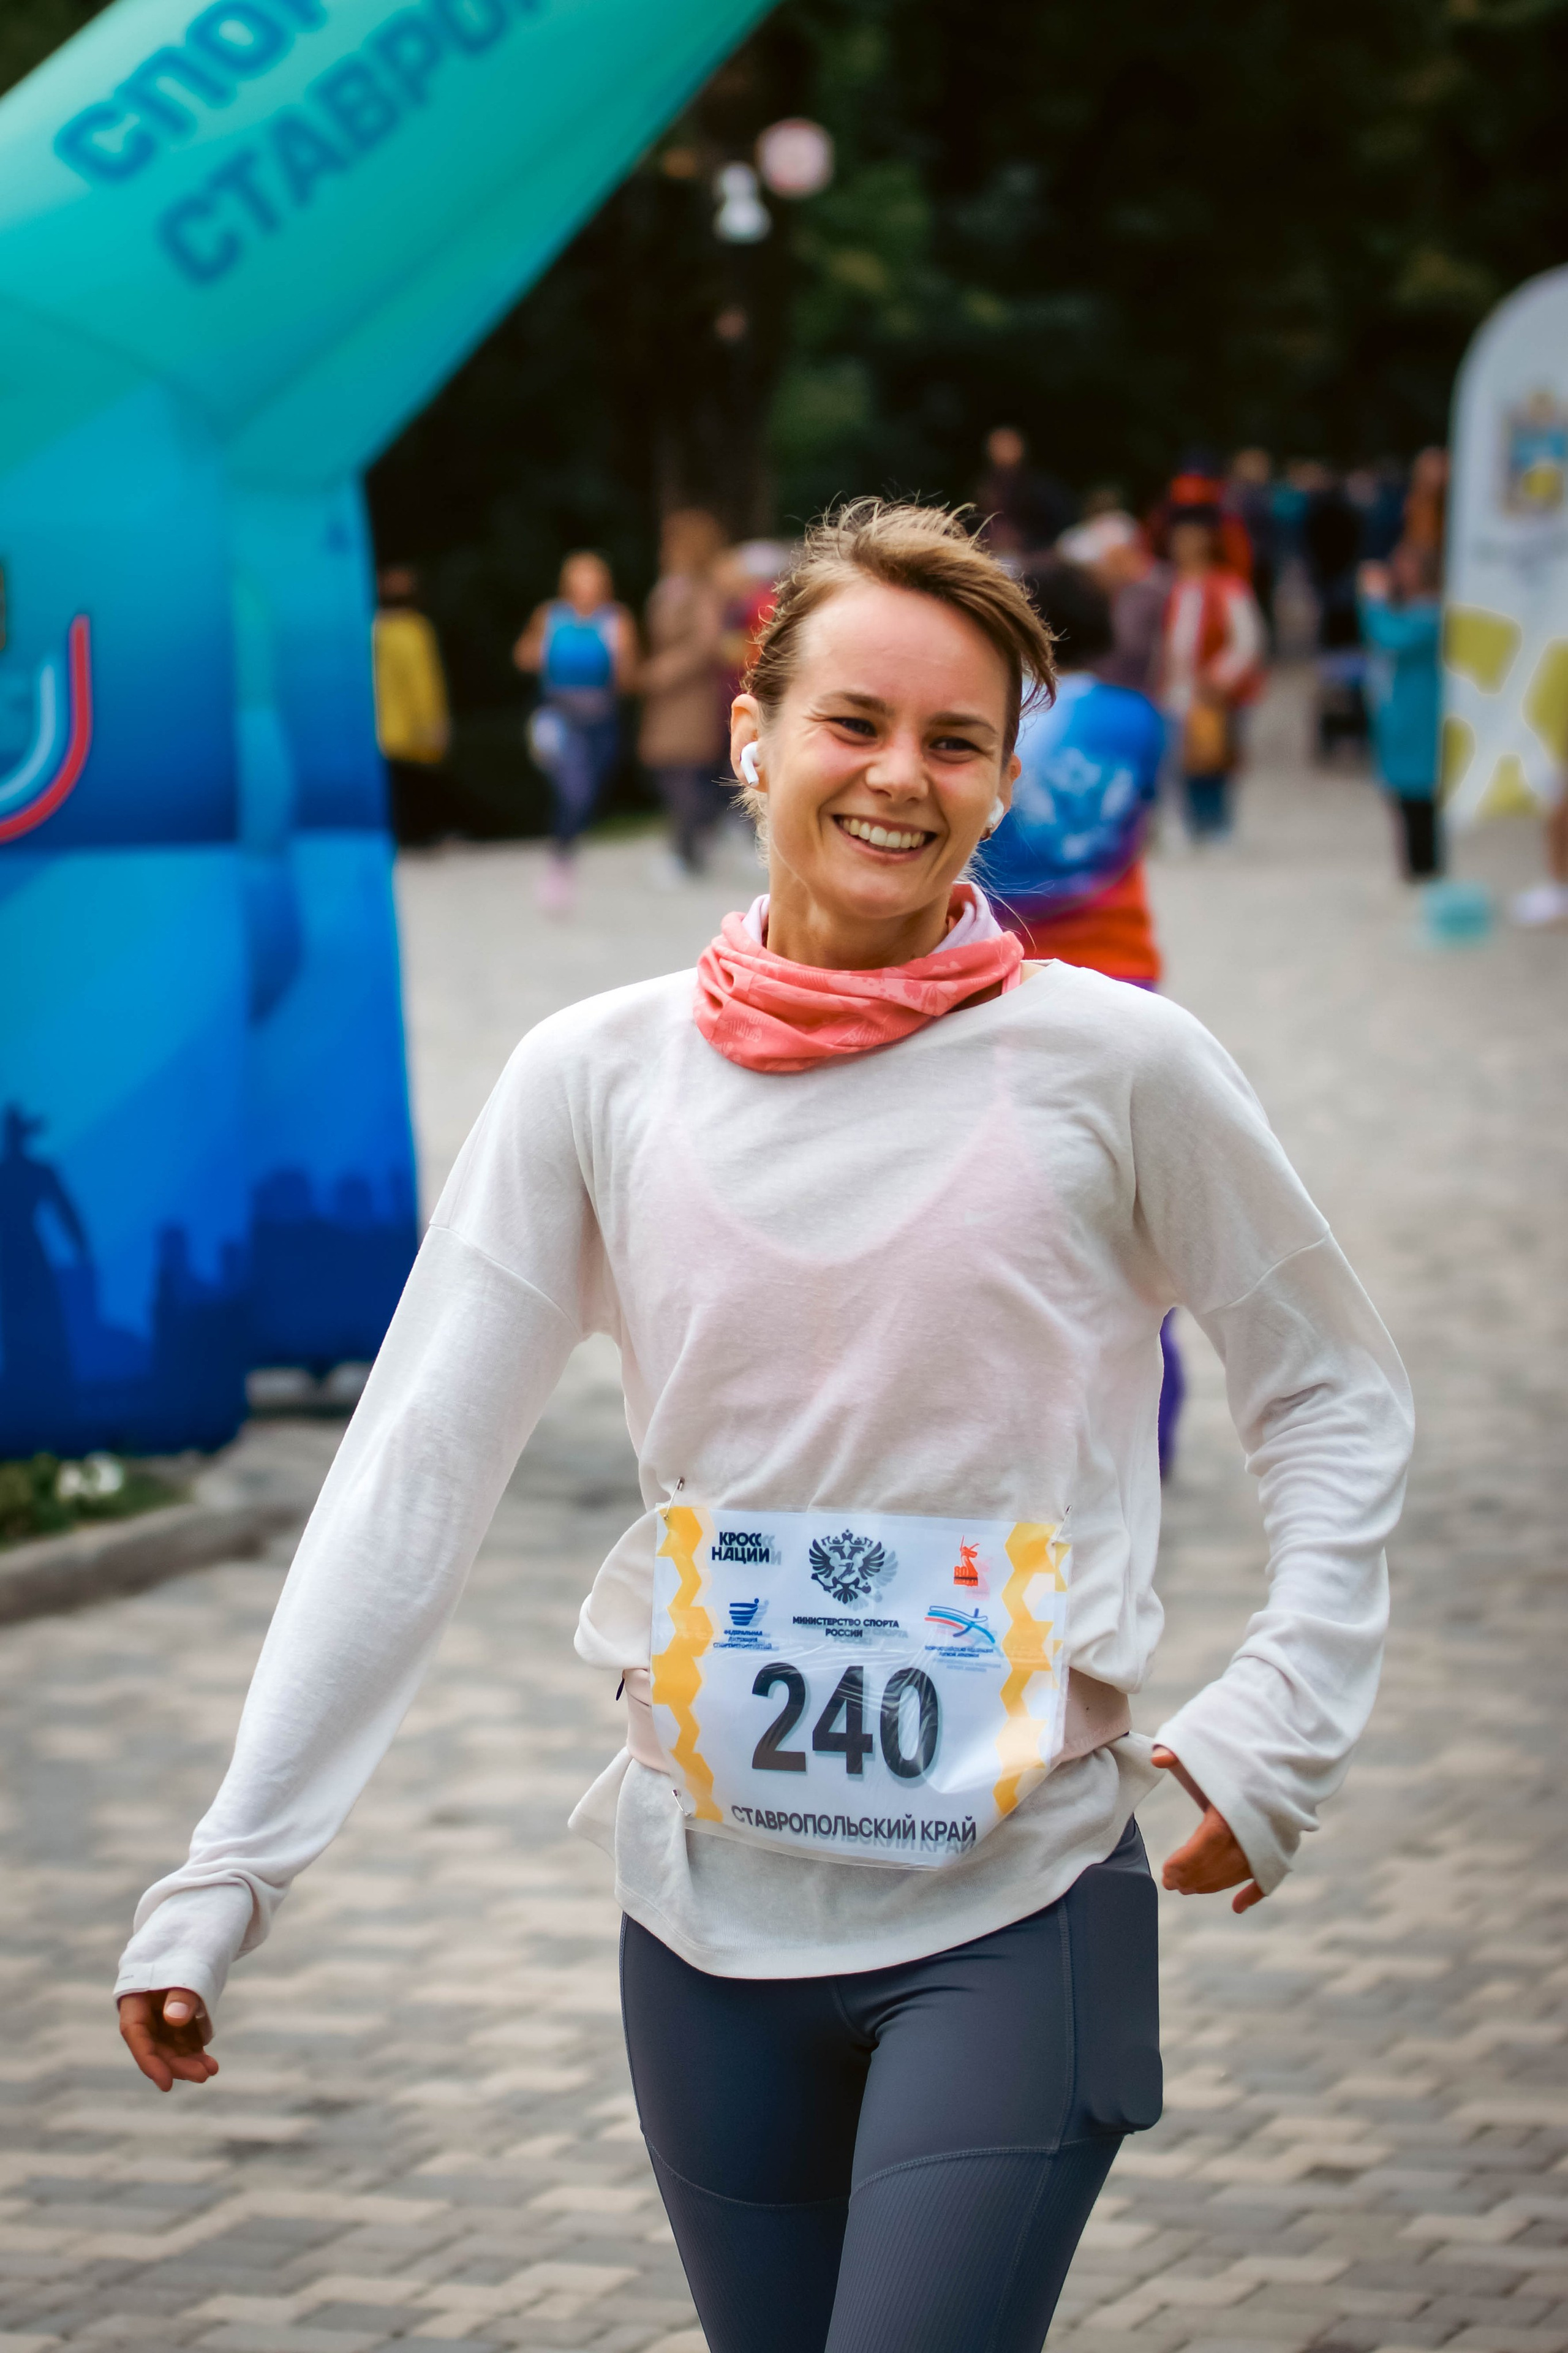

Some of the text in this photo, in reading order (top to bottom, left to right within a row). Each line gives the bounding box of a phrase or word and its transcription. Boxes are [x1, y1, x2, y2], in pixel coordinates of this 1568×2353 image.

[158, 0, 543, 284] СТАВРО
[719, 1532, 762, 1547] КРОСС
[711, 1546, 770, 1565] НАЦИИ
[793, 1615, 900, 1628] МИНИСТЕРСТВО СПОРТА
[826, 1628, 863, 1637] РОССИИ
[752, 1662, 938, 1778] 240
[731, 1805, 976, 1842] СТАВРОПОЛЬСКИЙ КРАЙ
